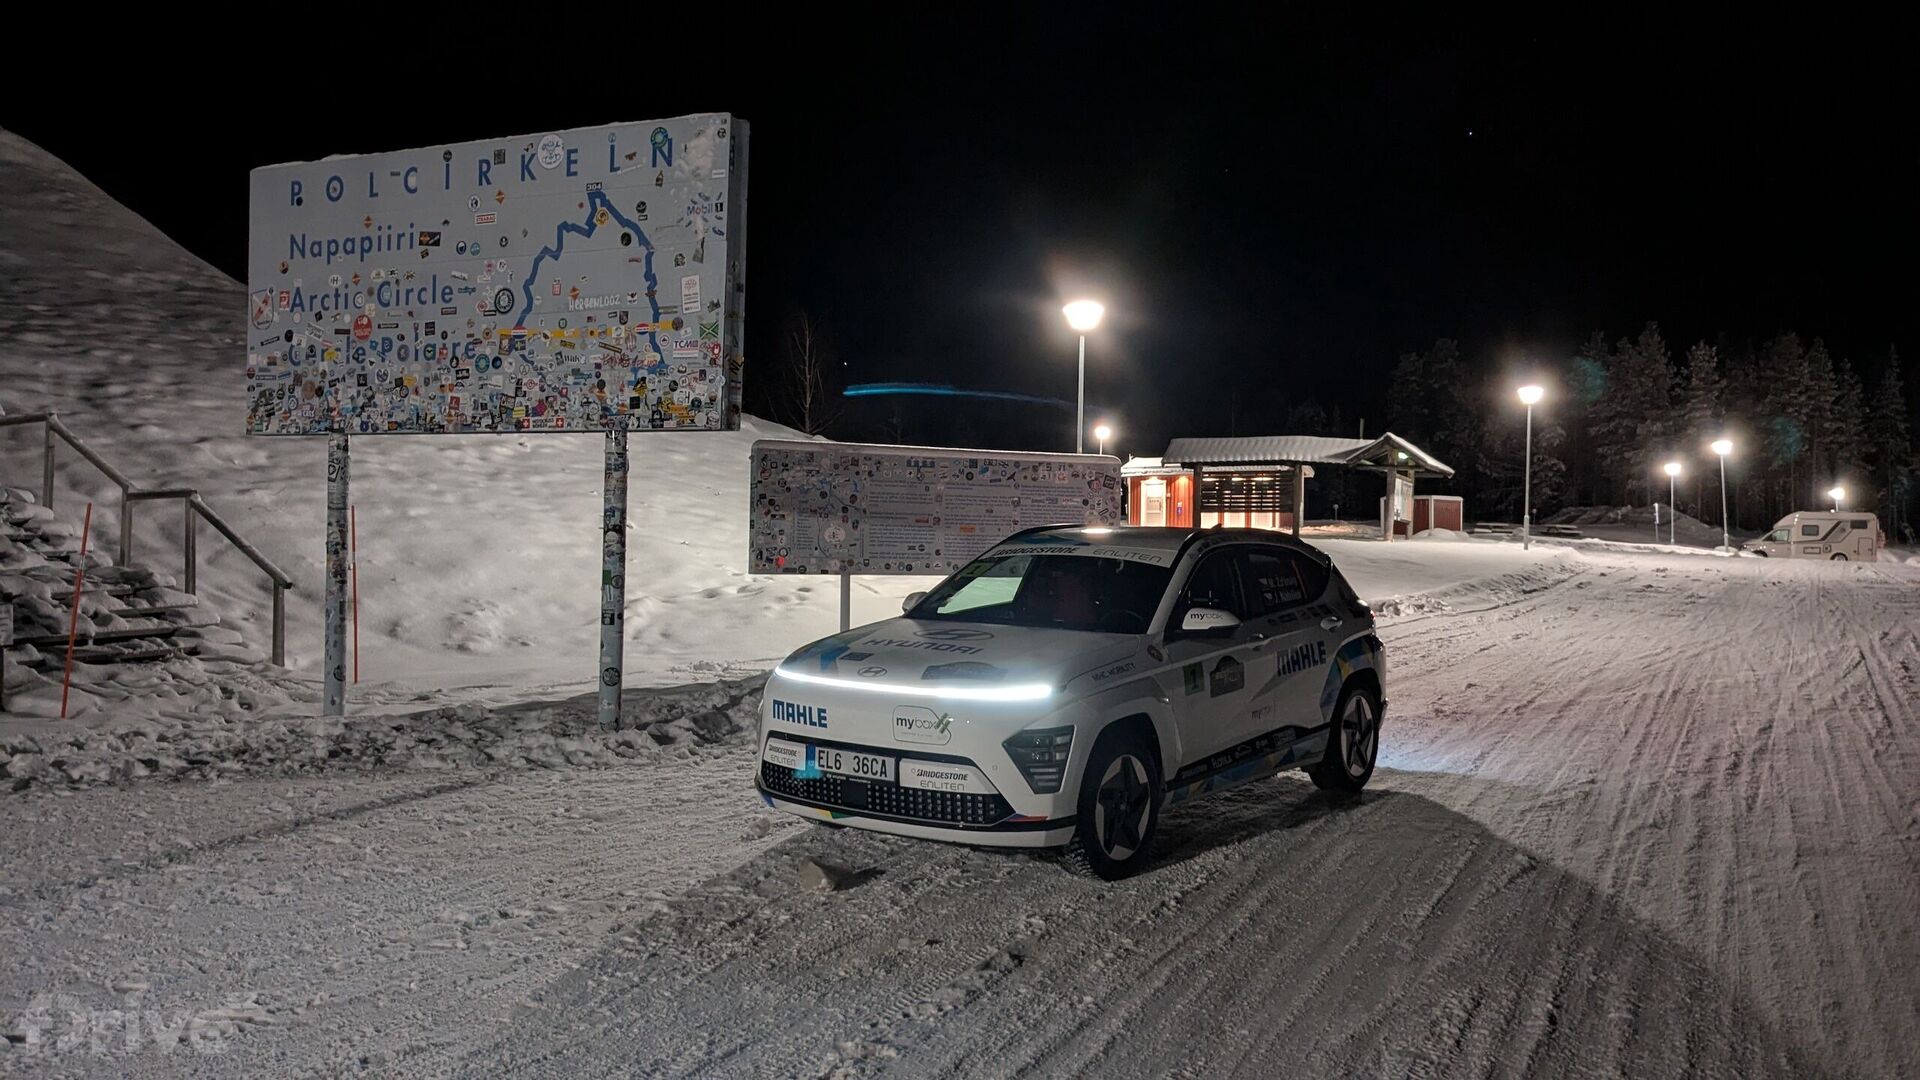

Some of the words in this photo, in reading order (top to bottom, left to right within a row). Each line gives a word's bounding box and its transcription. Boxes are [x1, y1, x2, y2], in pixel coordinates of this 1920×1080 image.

[289, 222, 415, 264] Napapiiri
[289, 284, 365, 312] Arctic
[376, 274, 454, 308] Circle
[993, 547, 1079, 557] BRIDGESTONE
[1092, 548, 1162, 563] ENLITEN
[862, 637, 985, 655] HYUNDAI
[1276, 641, 1327, 676] MAHLE
[772, 699, 828, 728] MAHLE
[818, 749, 842, 771] EL6
[853, 755, 888, 778] 36CA
[916, 768, 969, 781] BRIDGESTONE
[919, 781, 965, 791] ENLITEN
